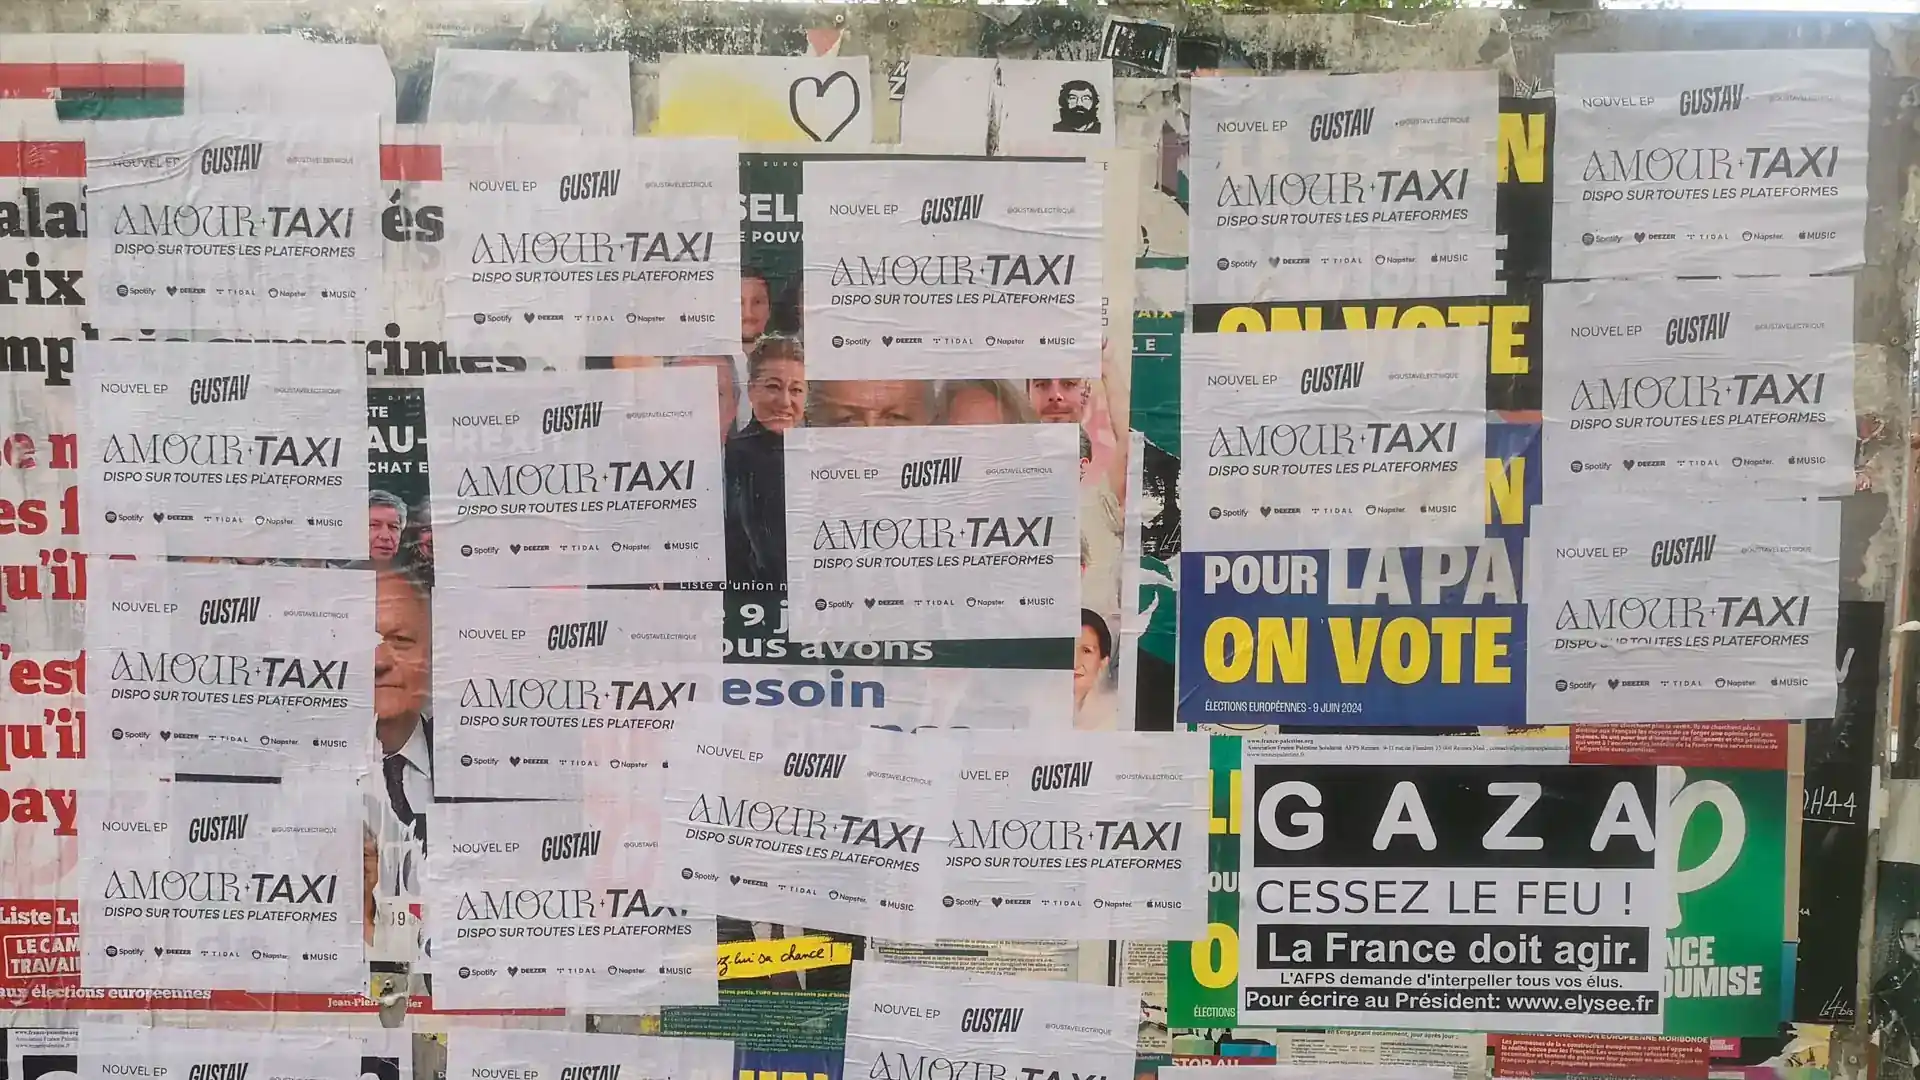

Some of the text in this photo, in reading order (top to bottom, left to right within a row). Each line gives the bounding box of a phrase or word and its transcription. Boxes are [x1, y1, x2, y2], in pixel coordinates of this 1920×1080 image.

[1678, 84, 1745, 117] GUSTAV
[1217, 107, 1375, 141] NOUVEL EP GUSTAV
[202, 144, 263, 174] GUSTAV
[469, 170, 621, 201] NOUVEL EP GUSTAV
[921, 194, 984, 225] GUSTAV
[831, 293, 1075, 305] DISPO SUR TOUTES LES PLATEFORMES
[1570, 312, 1731, 345] NOUVEL EP GUSTAV
[190, 375, 251, 404] GUSTAV
[1301, 362, 1365, 394] GUSTAV
[543, 402, 602, 434] GUSTAV
[103, 471, 342, 486] DISPO SUR TOUTES LES PLATEFORMES
[811, 469, 860, 479] NOUVEL
[864, 469, 878, 478] EP
[901, 457, 962, 488] GUSTAV
[1208, 460, 1457, 476] DISPO SUR TOUTES LES PLATEFORMES
[1651, 535, 1716, 566] GUSTAV
[719, 580, 774, 591] d'union
[1204, 555, 1318, 595] POUR
[1328, 547, 1412, 605] LA
[112, 597, 260, 624] NOUVEL EP GUSTAV
[828, 601, 854, 610] Spotify
[547, 621, 608, 649] GUSTAV
[800, 640, 934, 661] avons
[1203, 616, 1512, 685] ON VOTE
[1205, 699, 1248, 712] ÉLECTIONS
[1249, 700, 1307, 713] EUROPÉENNES
[1313, 703, 1319, 713] 9
[1320, 702, 1340, 713] JUIN
[1341, 702, 1363, 714] 2024
[697, 743, 847, 778] NOUVEL EP GUSTAV
[1031, 761, 1093, 790] GUSTAV
[103, 814, 248, 842] NOUVEL EP GUSTAV
[542, 831, 601, 861] GUSTAV
[955, 899, 981, 907] Spotify
[1256, 880, 1631, 915] CESSEZ LE FEU !
[0, 906, 52, 925] Liste
[457, 924, 692, 938] DISPO SUR TOUTES LES PLATEFORMES
[17, 939, 37, 955] LE
[780, 944, 825, 962] chance
[1269, 932, 1637, 972] La France doit agir.
[32, 985, 104, 999] élections
[1280, 972, 1623, 989] L'AFPS demande d'interpeller tous vos élus.
[1194, 1004, 1236, 1018] ÉLECTIONS
[1246, 991, 1654, 1014] Pour écrire au Président: www.elysee.fr
[874, 1003, 1024, 1031] NOUVEL EP GUSTAV
